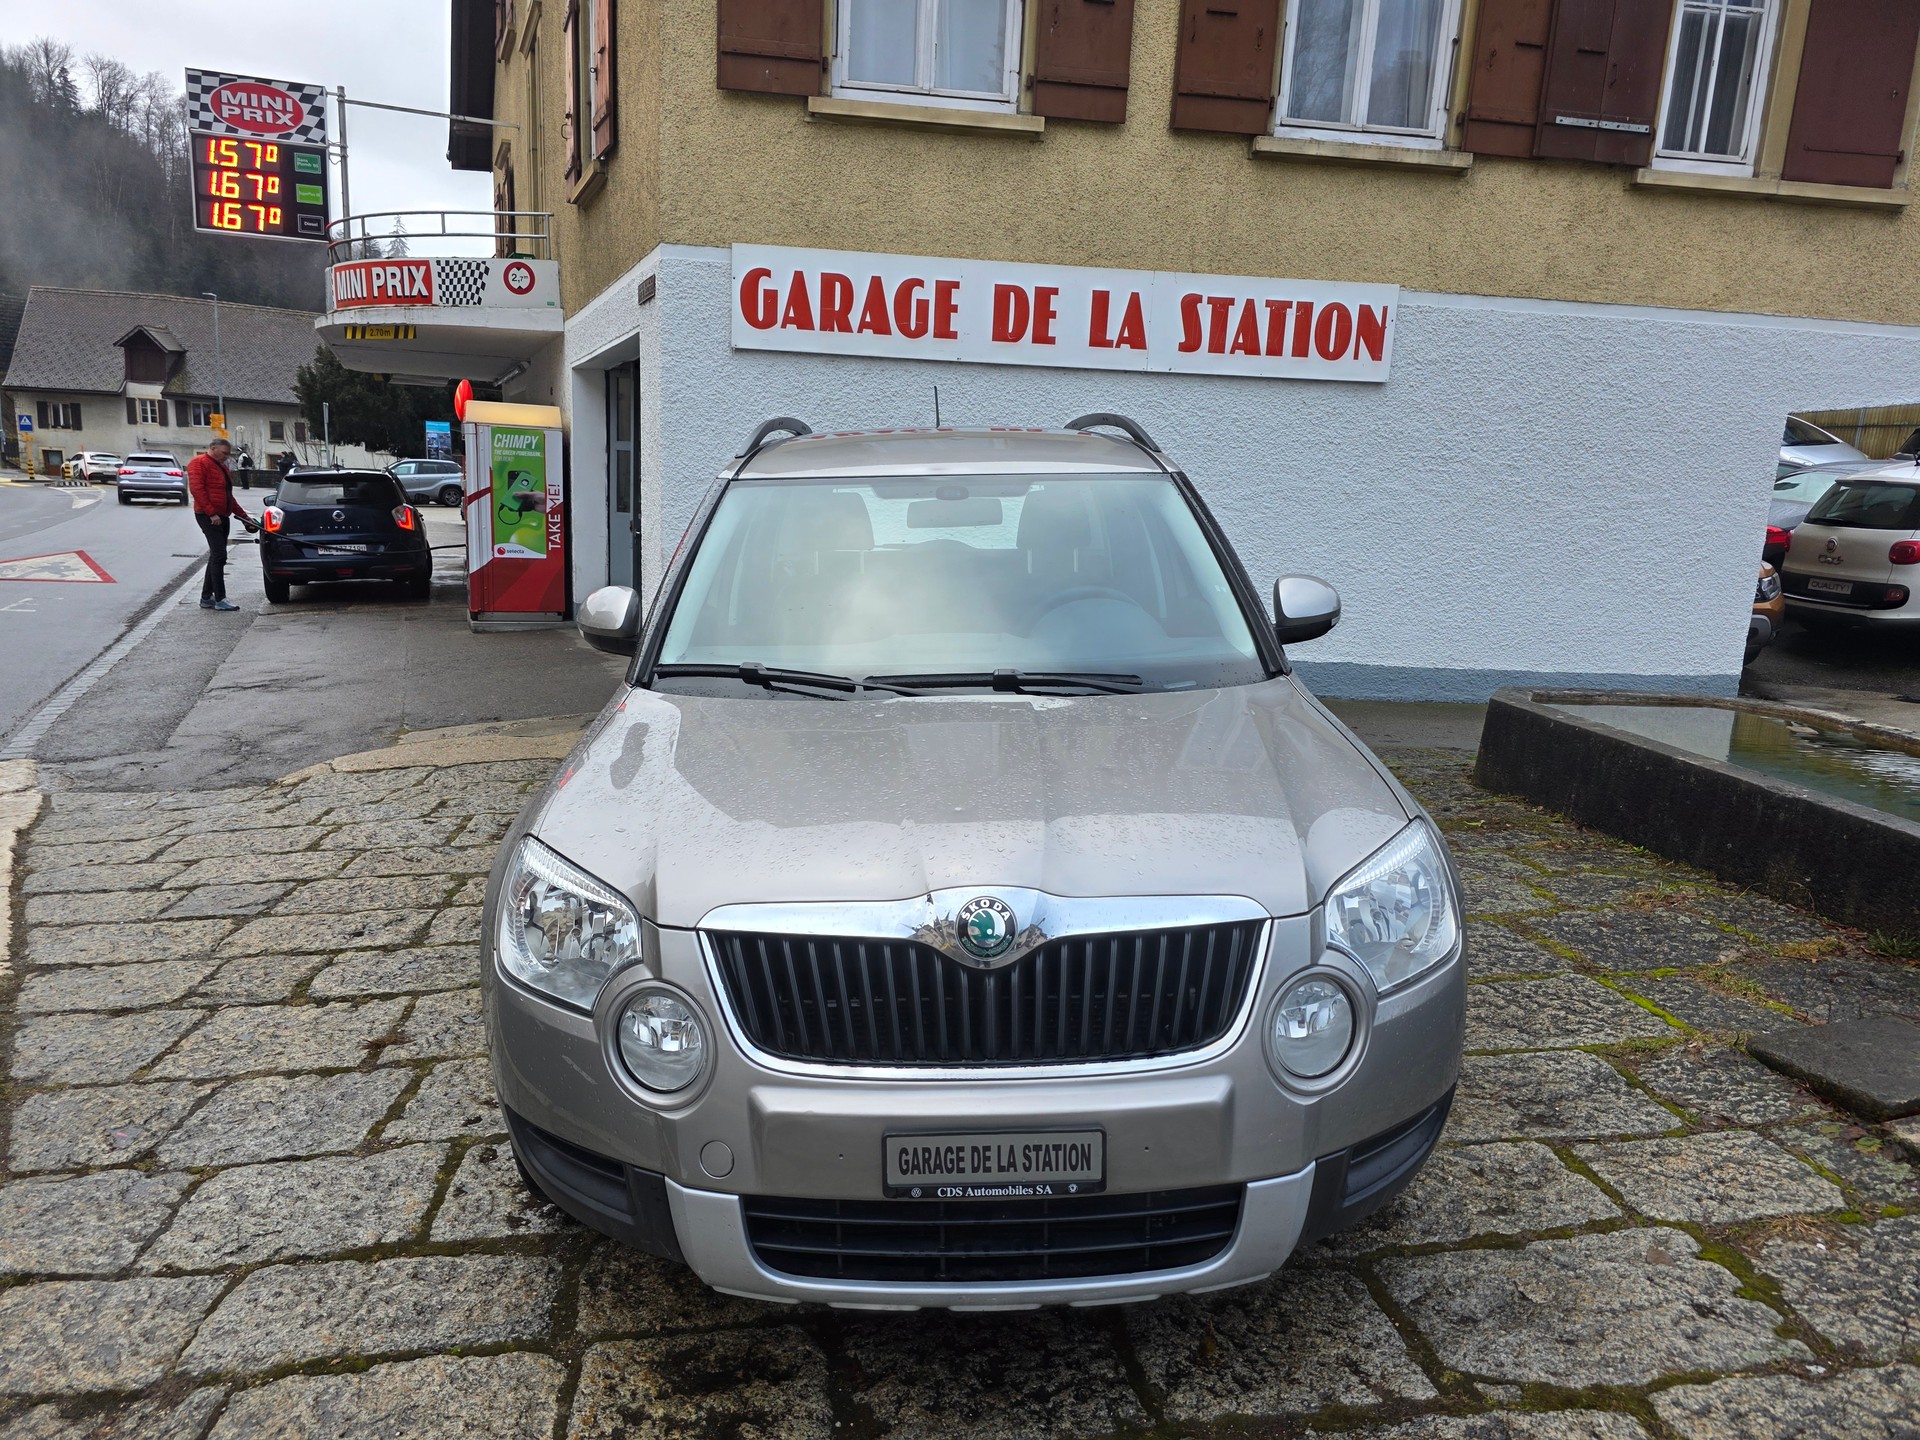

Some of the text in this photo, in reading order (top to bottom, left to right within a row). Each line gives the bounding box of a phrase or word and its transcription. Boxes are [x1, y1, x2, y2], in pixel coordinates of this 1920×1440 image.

[220, 89, 294, 112] MINI
[221, 105, 295, 127] PRIX
[335, 265, 429, 301] MINI PRIX
[740, 267, 1388, 361] GARAGE DE LA STATION
[494, 433, 539, 450] CHIMPY
[547, 513, 562, 551] TAKE
[898, 1142, 1093, 1176] GARAGE DE LA STATION
[936, 1186, 964, 1198] CDS
[965, 1184, 1034, 1197] Automobiles
[1035, 1184, 1053, 1195] SA
